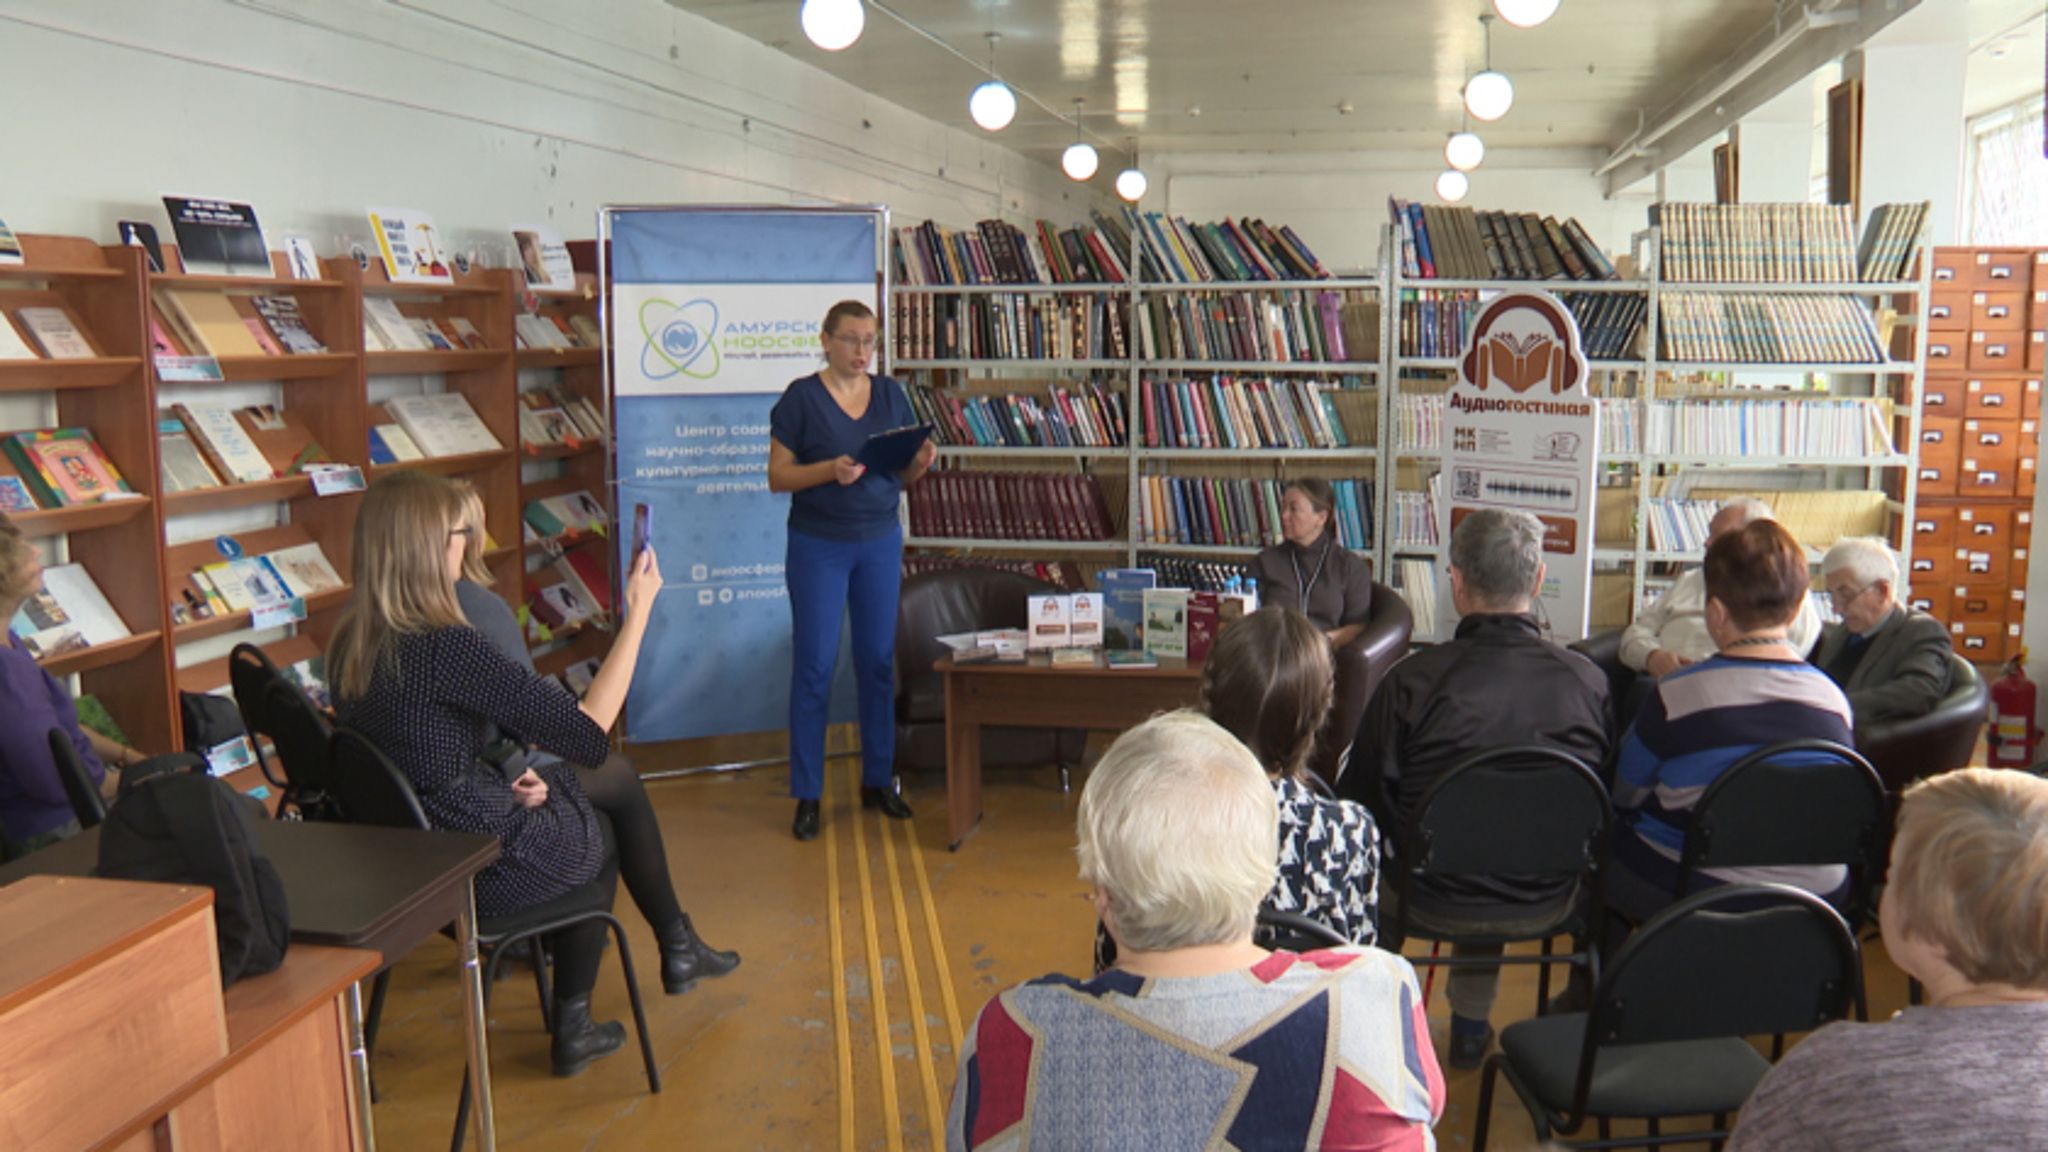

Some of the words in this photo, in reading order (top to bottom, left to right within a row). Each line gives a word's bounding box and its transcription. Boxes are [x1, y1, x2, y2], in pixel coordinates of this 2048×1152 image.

[723, 320, 819, 334] АМУРСК
[1450, 392, 1591, 417] Аудиогостиная
[675, 424, 727, 438] Центр
